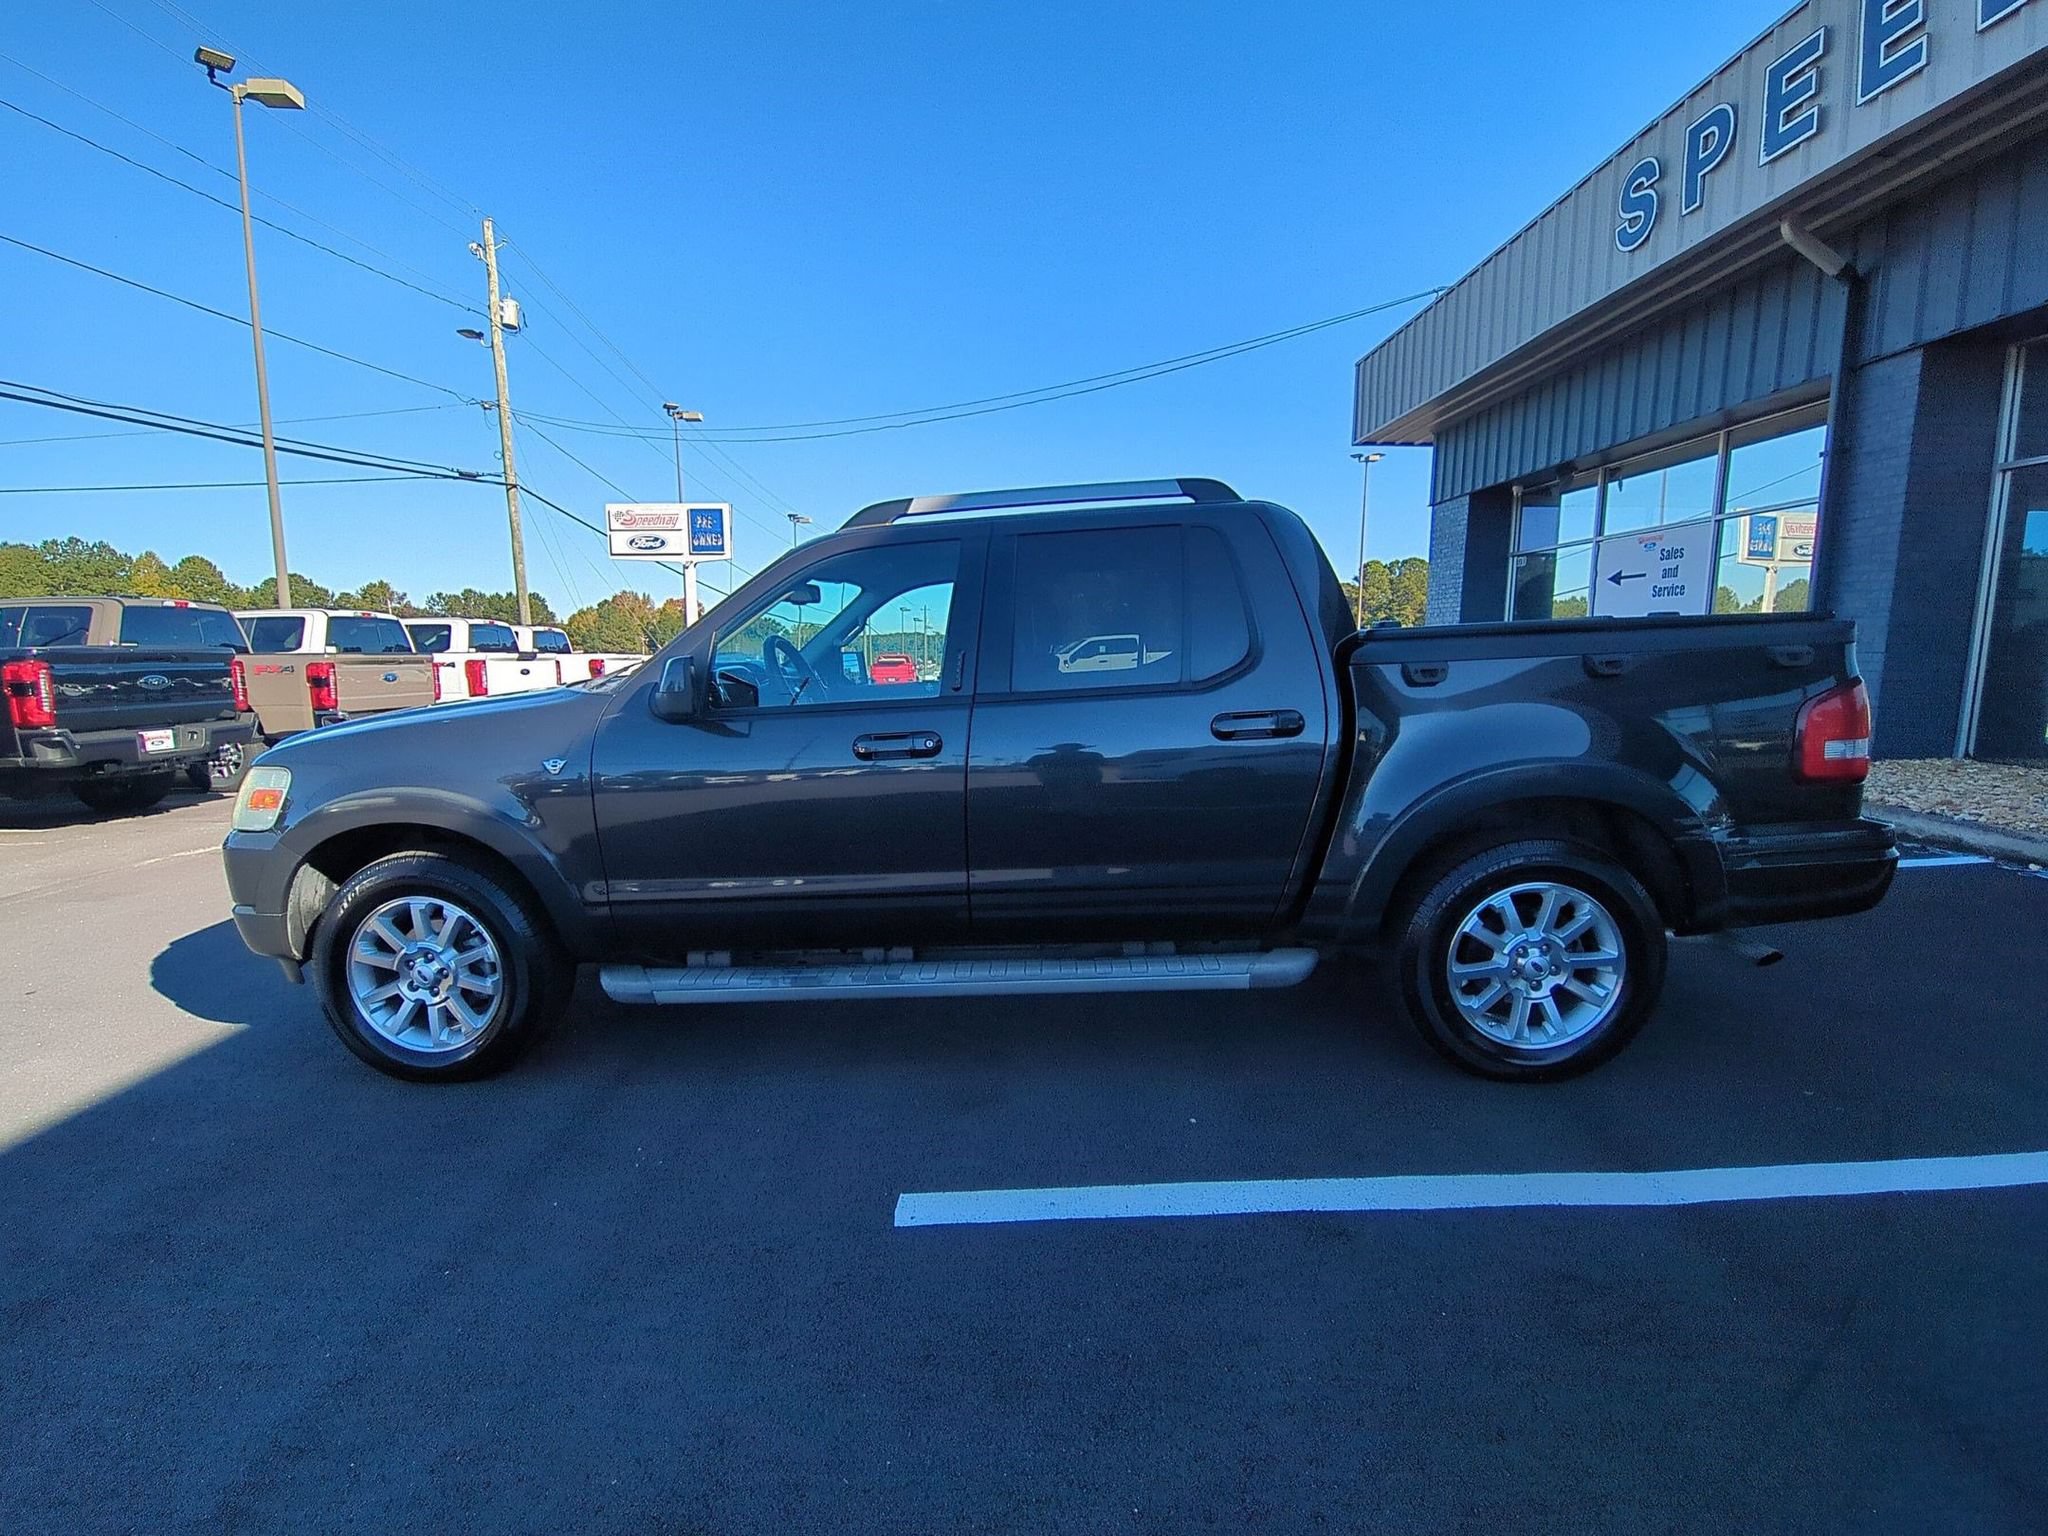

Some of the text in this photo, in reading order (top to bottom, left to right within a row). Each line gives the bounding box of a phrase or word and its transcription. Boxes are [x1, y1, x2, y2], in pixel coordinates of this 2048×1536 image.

[1615, 0, 2032, 253] SPEE
[620, 509, 680, 528] Speedway
[630, 536, 664, 549] Ford
[1659, 547, 1685, 561] Sales
[1661, 564, 1679, 579] and
[1652, 583, 1686, 598] Service
